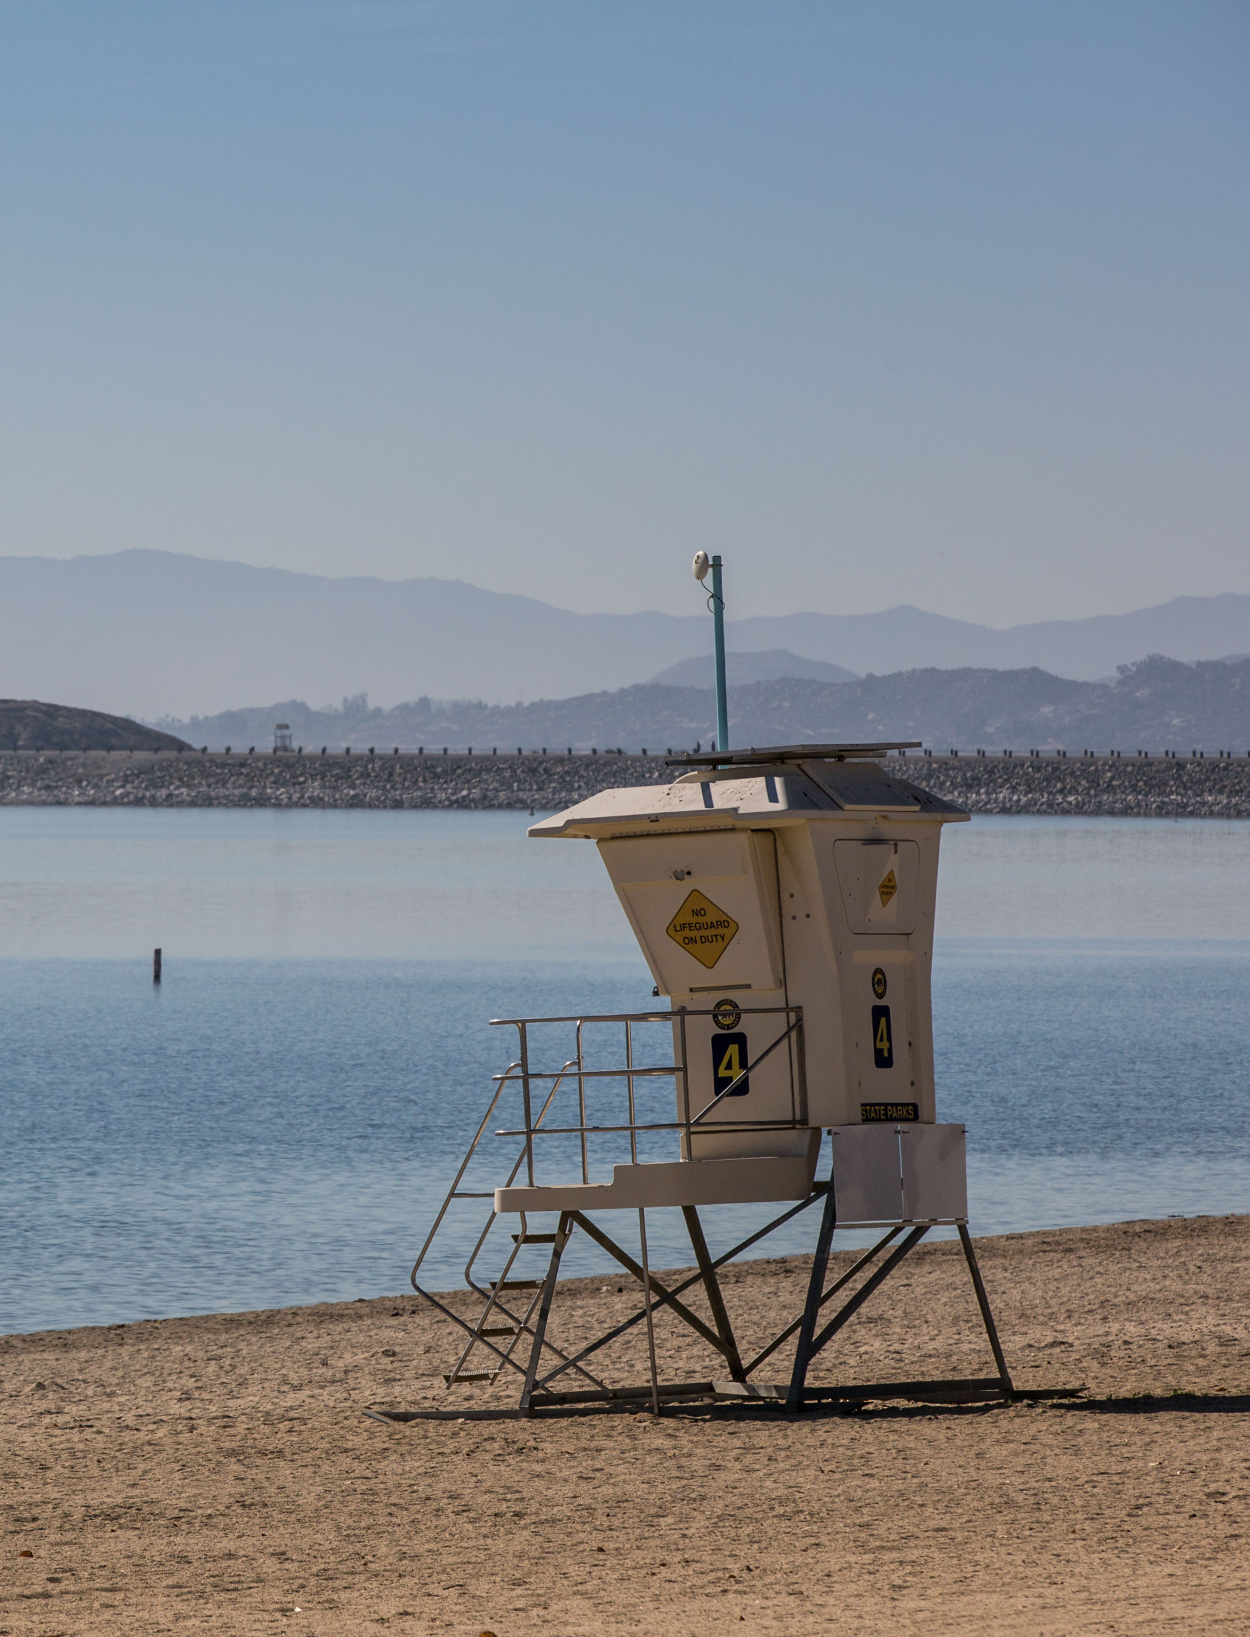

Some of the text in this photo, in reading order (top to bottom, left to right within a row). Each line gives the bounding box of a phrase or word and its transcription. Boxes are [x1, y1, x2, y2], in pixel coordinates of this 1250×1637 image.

[691, 908, 707, 917] NO
[673, 920, 730, 932] LIFEGUARD
[682, 934, 726, 945] ON DUTY
[876, 1016, 890, 1057] 4
[718, 1044, 744, 1085] 4
[861, 1105, 914, 1119] STATE PARKS
